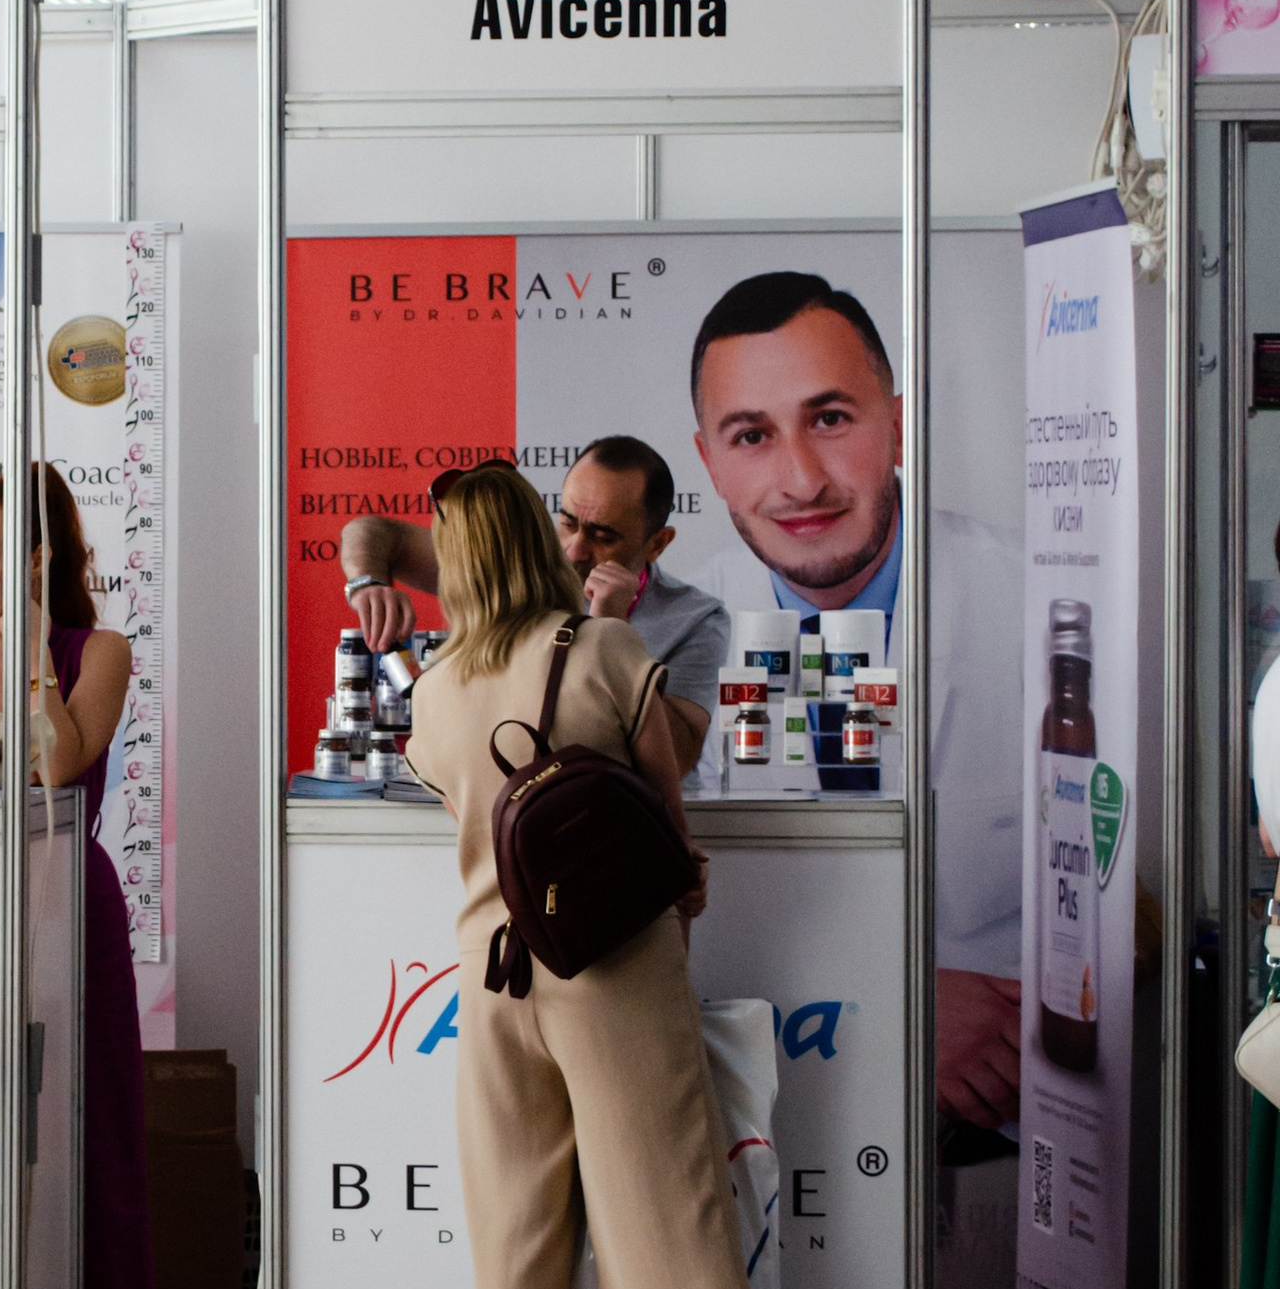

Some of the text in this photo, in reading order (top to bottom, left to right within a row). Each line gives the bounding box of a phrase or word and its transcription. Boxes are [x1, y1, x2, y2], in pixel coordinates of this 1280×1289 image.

[136, 248, 154, 258] 130
[350, 272, 630, 302] BE BRAVE
[136, 302, 154, 312] 120
[350, 309, 382, 321] BY
[135, 356, 153, 366] 110
[135, 410, 153, 420] 100
[300, 446, 580, 471] НОВЫЕ, СОВРЕМЕН
[140, 464, 152, 474] 90
[140, 518, 152, 528] 80
[140, 572, 152, 582] 70
[139, 626, 152, 635] 60
[139, 680, 152, 690] 50
[138, 733, 151, 743] 40
[138, 786, 151, 796] 30
[138, 840, 151, 850] 20
[138, 894, 150, 904] 10
[332, 1228, 384, 1243] BY
